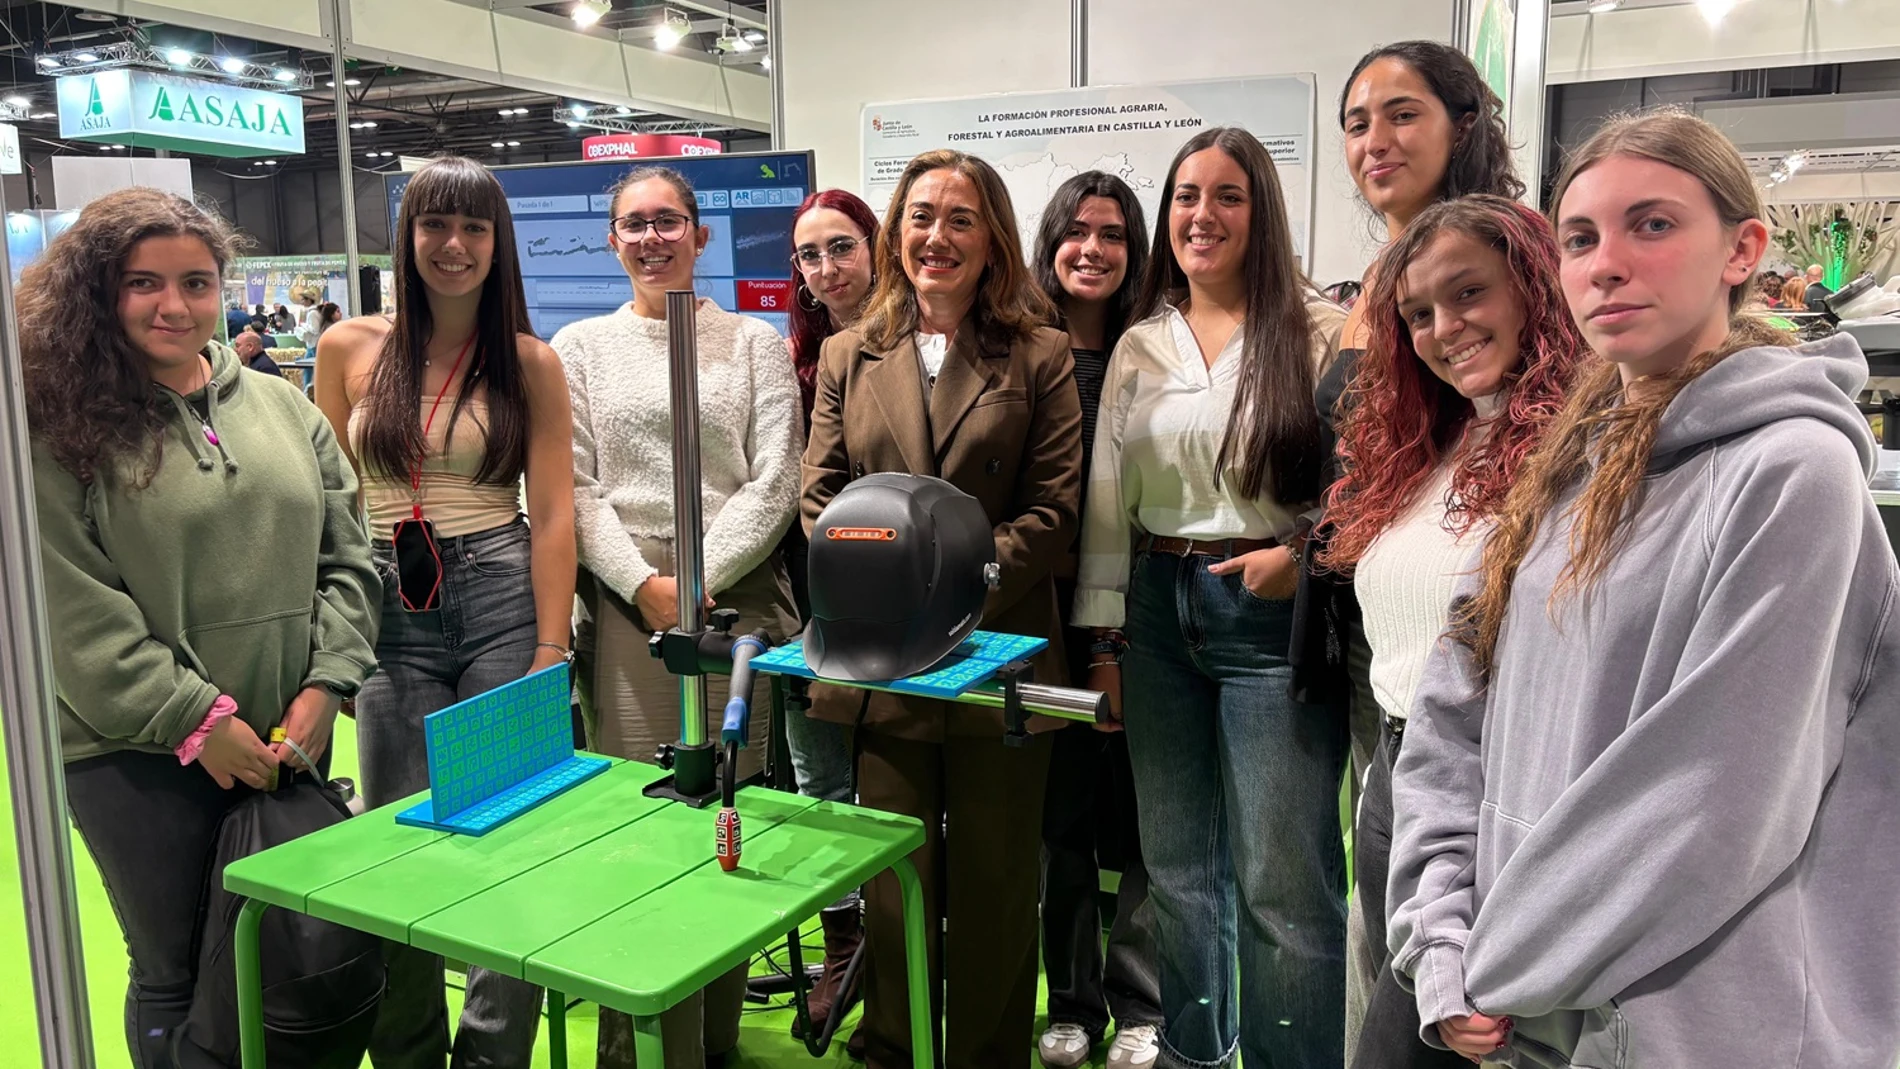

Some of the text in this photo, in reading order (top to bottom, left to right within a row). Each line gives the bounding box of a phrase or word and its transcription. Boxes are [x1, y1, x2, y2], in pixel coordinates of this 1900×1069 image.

[177, 92, 293, 136] ASAJA
[978, 103, 1168, 123] LA FORMACIÓN PROFESIONAL AGRARIA,
[80, 116, 112, 132] ASAJA
[948, 117, 1202, 141] FORESTAL Y AGROALIMENTARIA EN CASTILLA Y LEÓN
[588, 142, 638, 157] COEXPHAL
[1268, 147, 1296, 155] uperior
[735, 191, 750, 200] AR
[251, 276, 264, 286] del
[748, 281, 787, 289] Puntuación
[760, 296, 776, 307] 85
